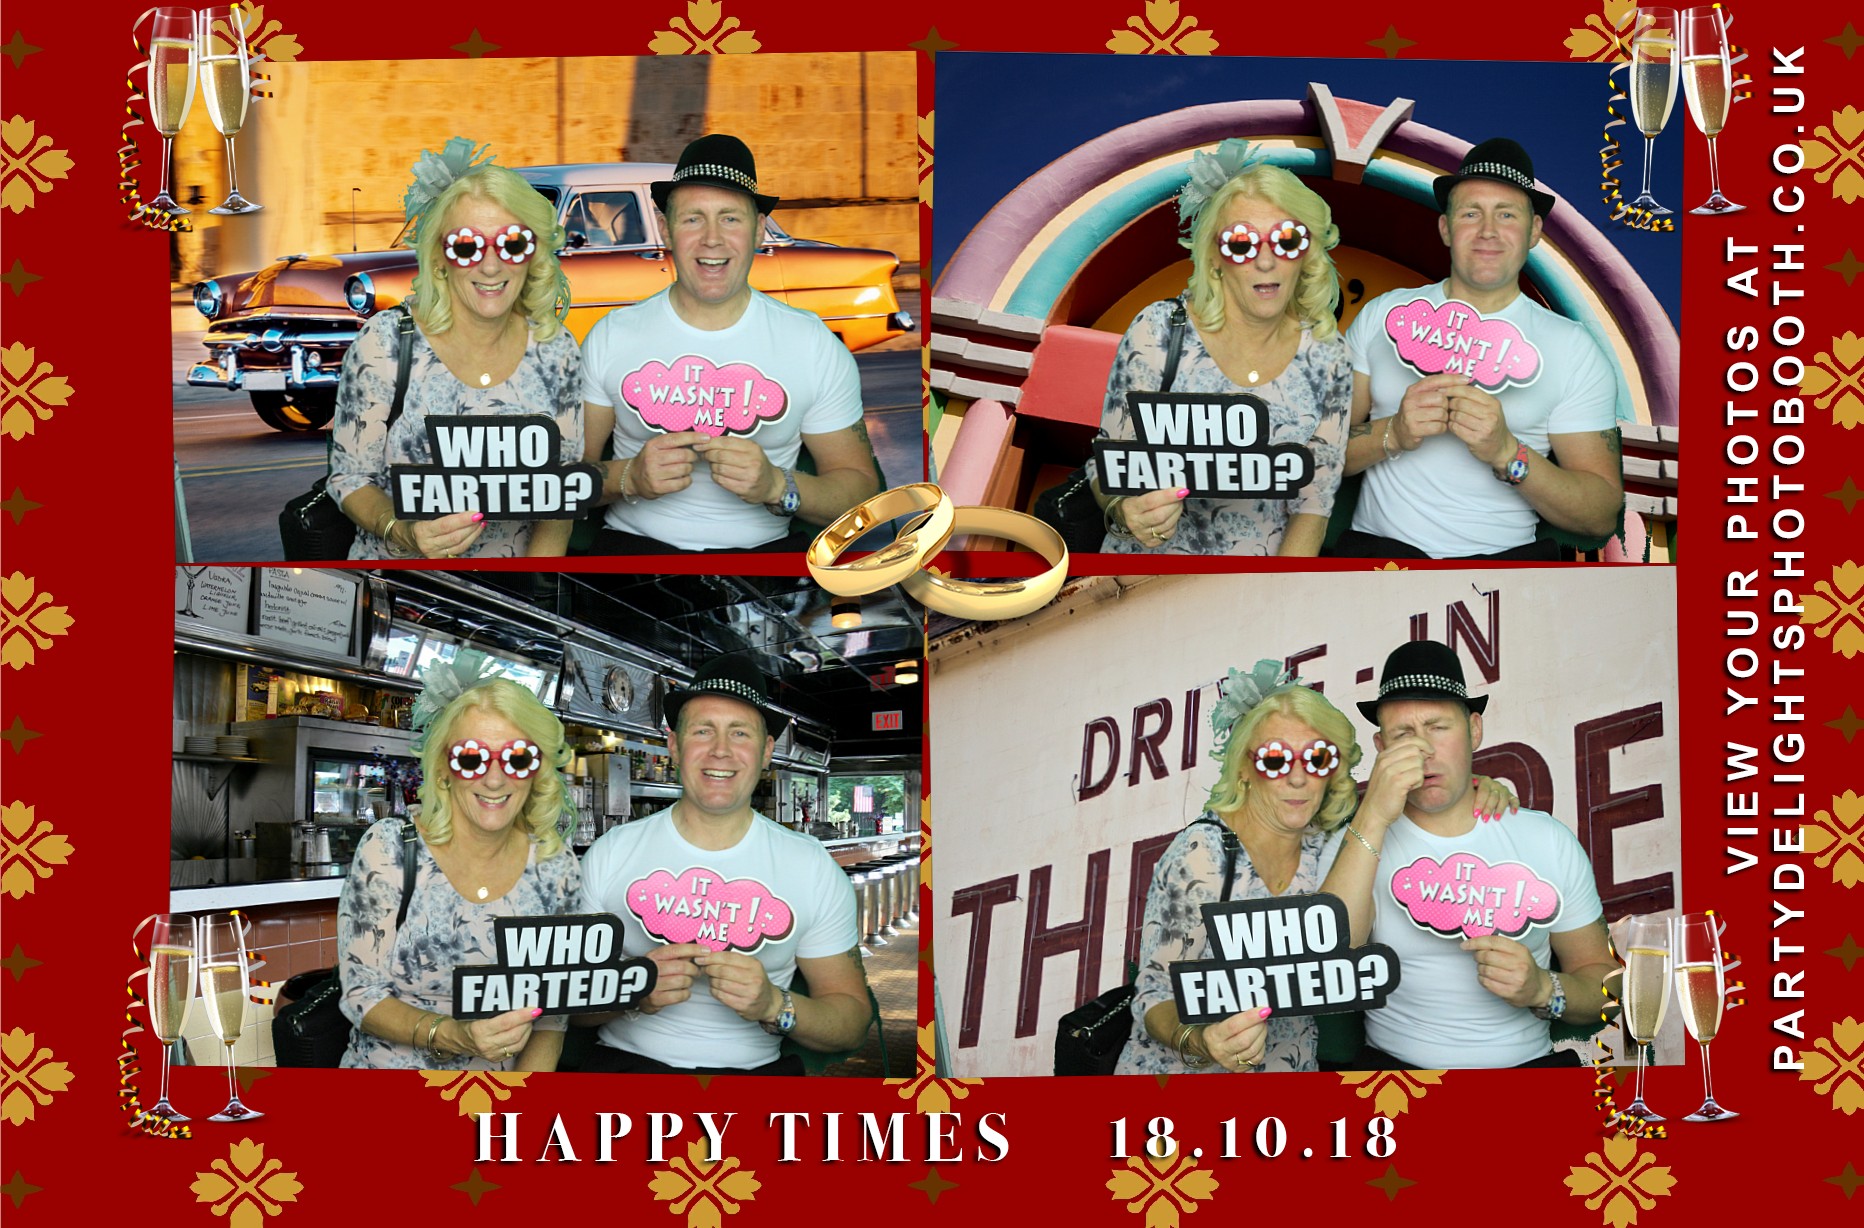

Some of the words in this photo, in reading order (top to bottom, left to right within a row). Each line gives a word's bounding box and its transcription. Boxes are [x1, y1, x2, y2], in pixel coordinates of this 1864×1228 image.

[1447, 310, 1469, 330] IT
[1411, 321, 1493, 362] WASN'T
[684, 365, 705, 383] IT
[1445, 354, 1476, 378] ME
[648, 385, 736, 408] WASN'T
[694, 407, 725, 427] ME
[1138, 402, 1258, 446] WHO
[436, 424, 549, 468] WHO
[1103, 450, 1302, 492] FARTED?
[399, 471, 592, 514] FARTED?
[876, 713, 899, 730] EXIT
[691, 876, 713, 896] IT
[1456, 862, 1476, 881] IT
[654, 893, 741, 923] WASN'T
[1418, 880, 1506, 909] WASN'T
[697, 922, 729, 943] ME
[1463, 907, 1495, 929] ME
[504, 923, 614, 968] WHO
[1213, 904, 1338, 962] WHO
[461, 966, 649, 1014] FARTED?
[1179, 954, 1389, 1017] FARTED?
